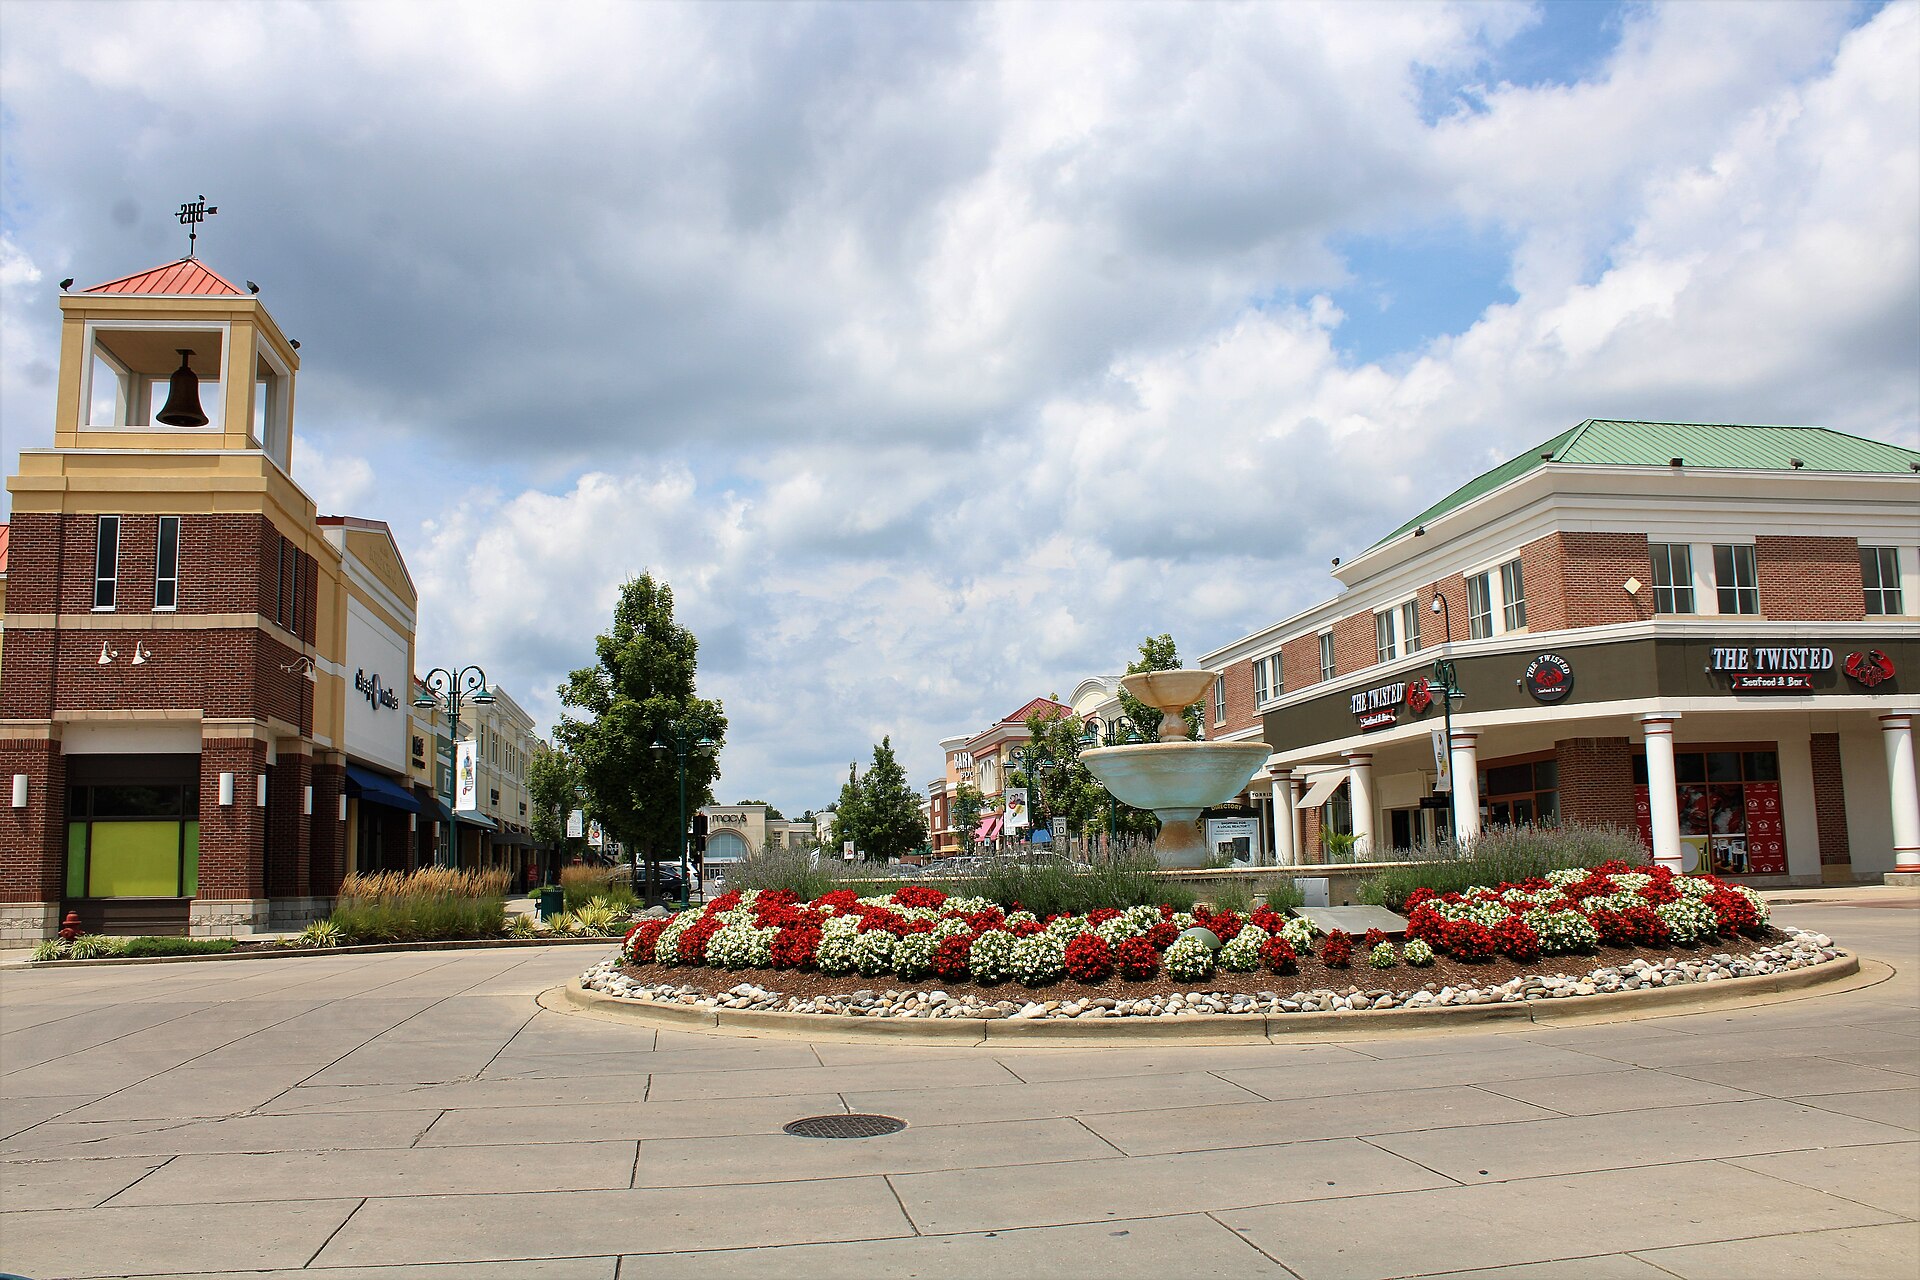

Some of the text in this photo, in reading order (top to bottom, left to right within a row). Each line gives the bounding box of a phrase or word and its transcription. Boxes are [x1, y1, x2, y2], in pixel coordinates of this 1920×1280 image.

[1526, 654, 1570, 678] THE TWISTED
[1713, 648, 1834, 670] THE TWISTED
[1741, 676, 1803, 687] Seafood & Bar
[1351, 692, 1367, 714] THE
[1368, 682, 1406, 710] TWISTED
[712, 812, 747, 824] macy's
[1055, 826, 1065, 834] 10
